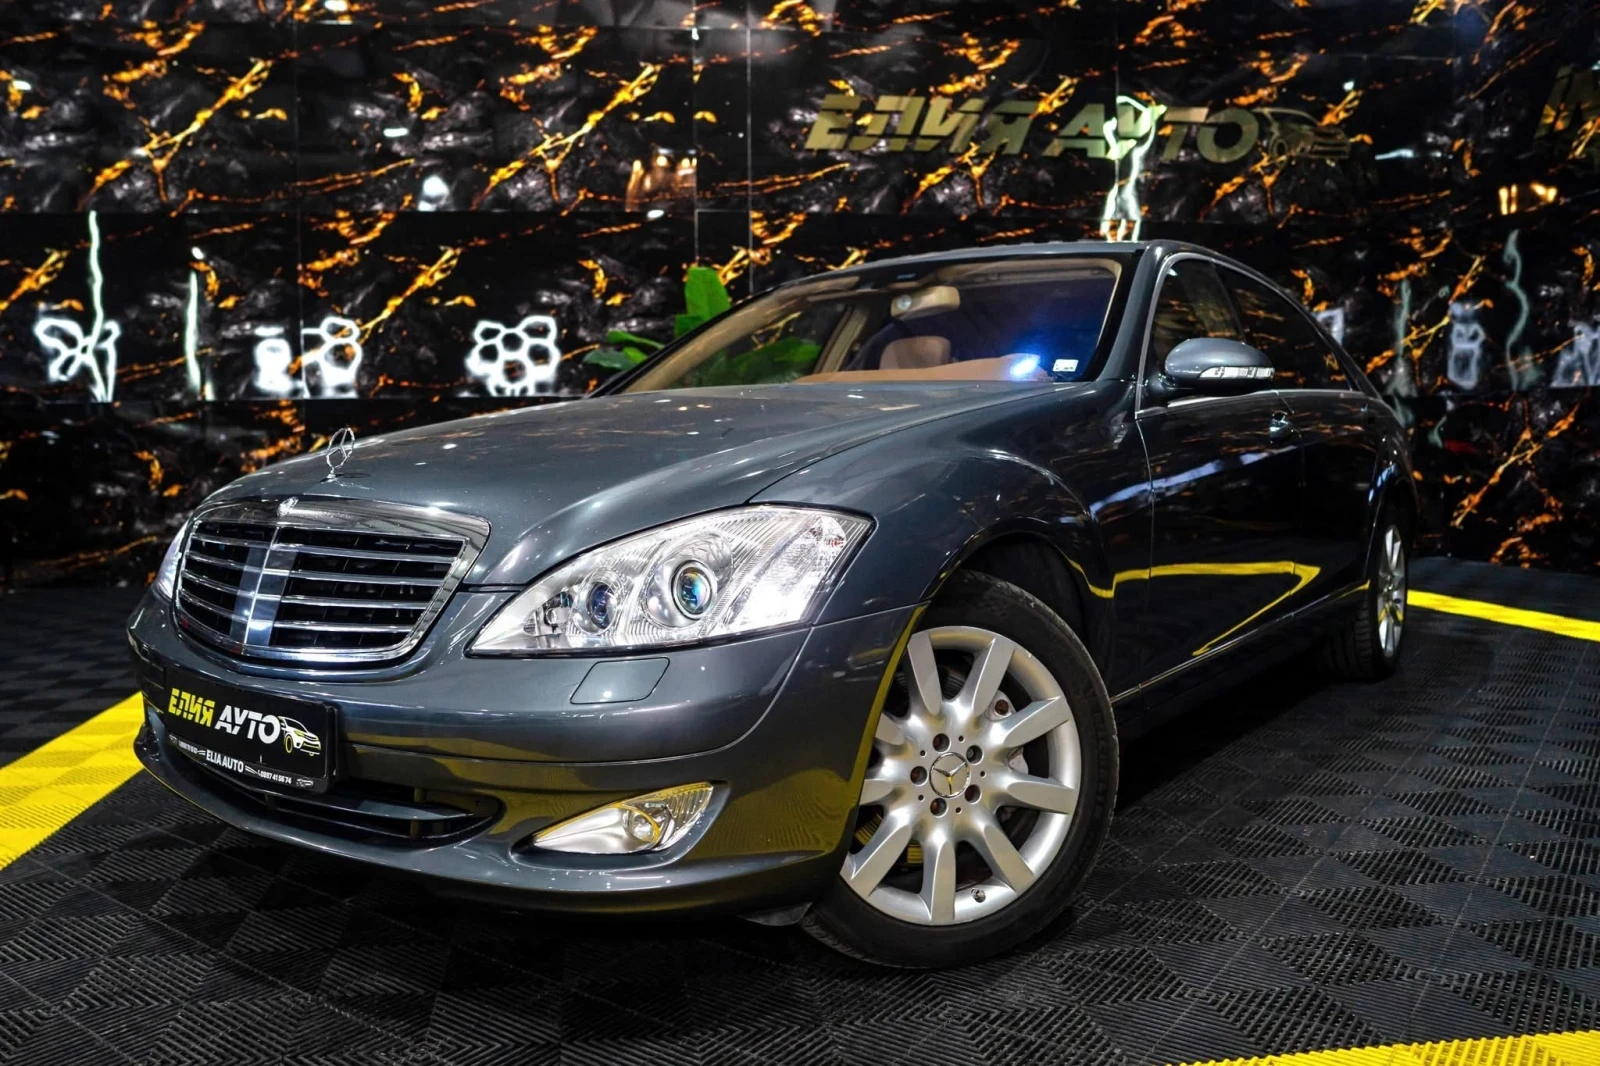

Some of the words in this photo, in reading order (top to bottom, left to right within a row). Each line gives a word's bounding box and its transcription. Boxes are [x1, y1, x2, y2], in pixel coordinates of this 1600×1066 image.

[168, 687, 216, 728] ЕЛИЯ
[206, 749, 222, 767] ELIA
[221, 755, 244, 774] AUTO
